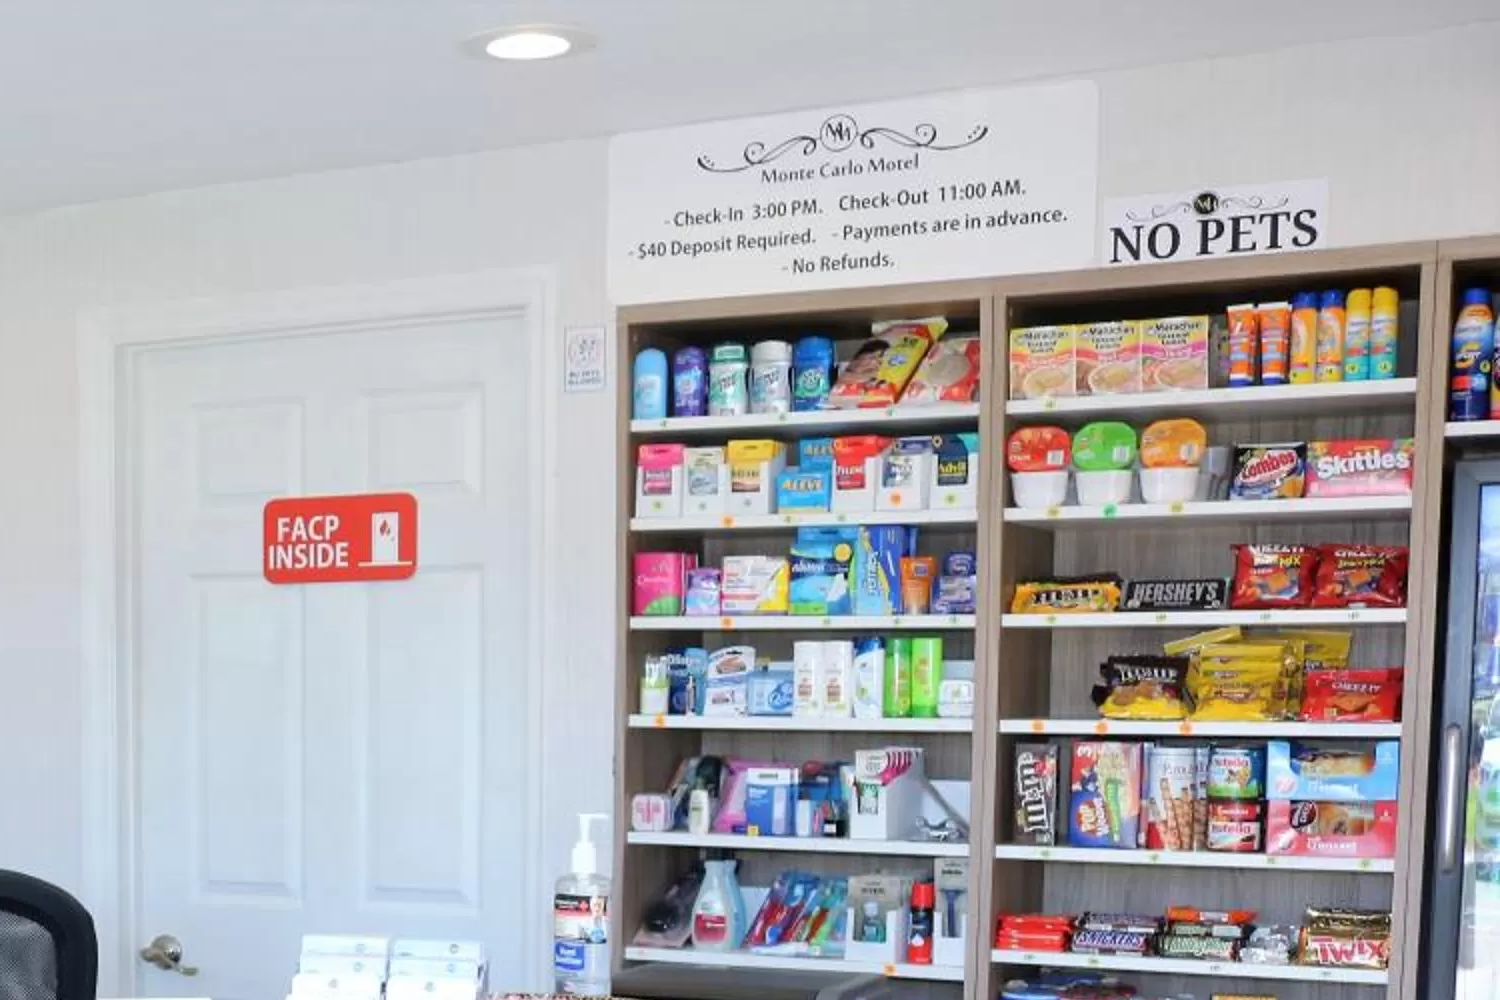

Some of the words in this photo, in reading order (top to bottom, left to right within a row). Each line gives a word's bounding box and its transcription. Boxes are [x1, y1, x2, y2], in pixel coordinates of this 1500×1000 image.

[761, 166, 815, 184] Monte
[819, 159, 863, 178] Carlo
[868, 153, 920, 174] Motel
[673, 208, 744, 227] Check-In
[752, 202, 787, 220] 3:00
[791, 199, 824, 216] PM.
[839, 188, 929, 211] Check-Out
[939, 182, 987, 202] 11:00
[991, 179, 1027, 197] AM.
[638, 243, 666, 259] $40
[671, 237, 732, 260] Deposit
[737, 228, 816, 253] Required.
[843, 219, 928, 242] Payments
[932, 217, 959, 232] are
[965, 213, 981, 230] in
[986, 208, 1068, 228] advance.
[1110, 222, 1181, 263] NO
[1196, 208, 1318, 256] PETS
[792, 258, 815, 274] No
[820, 251, 895, 272] Refunds.
[1318, 448, 1409, 479] Skittles
[277, 514, 340, 542] FACP
[269, 542, 349, 570] INSIDE
